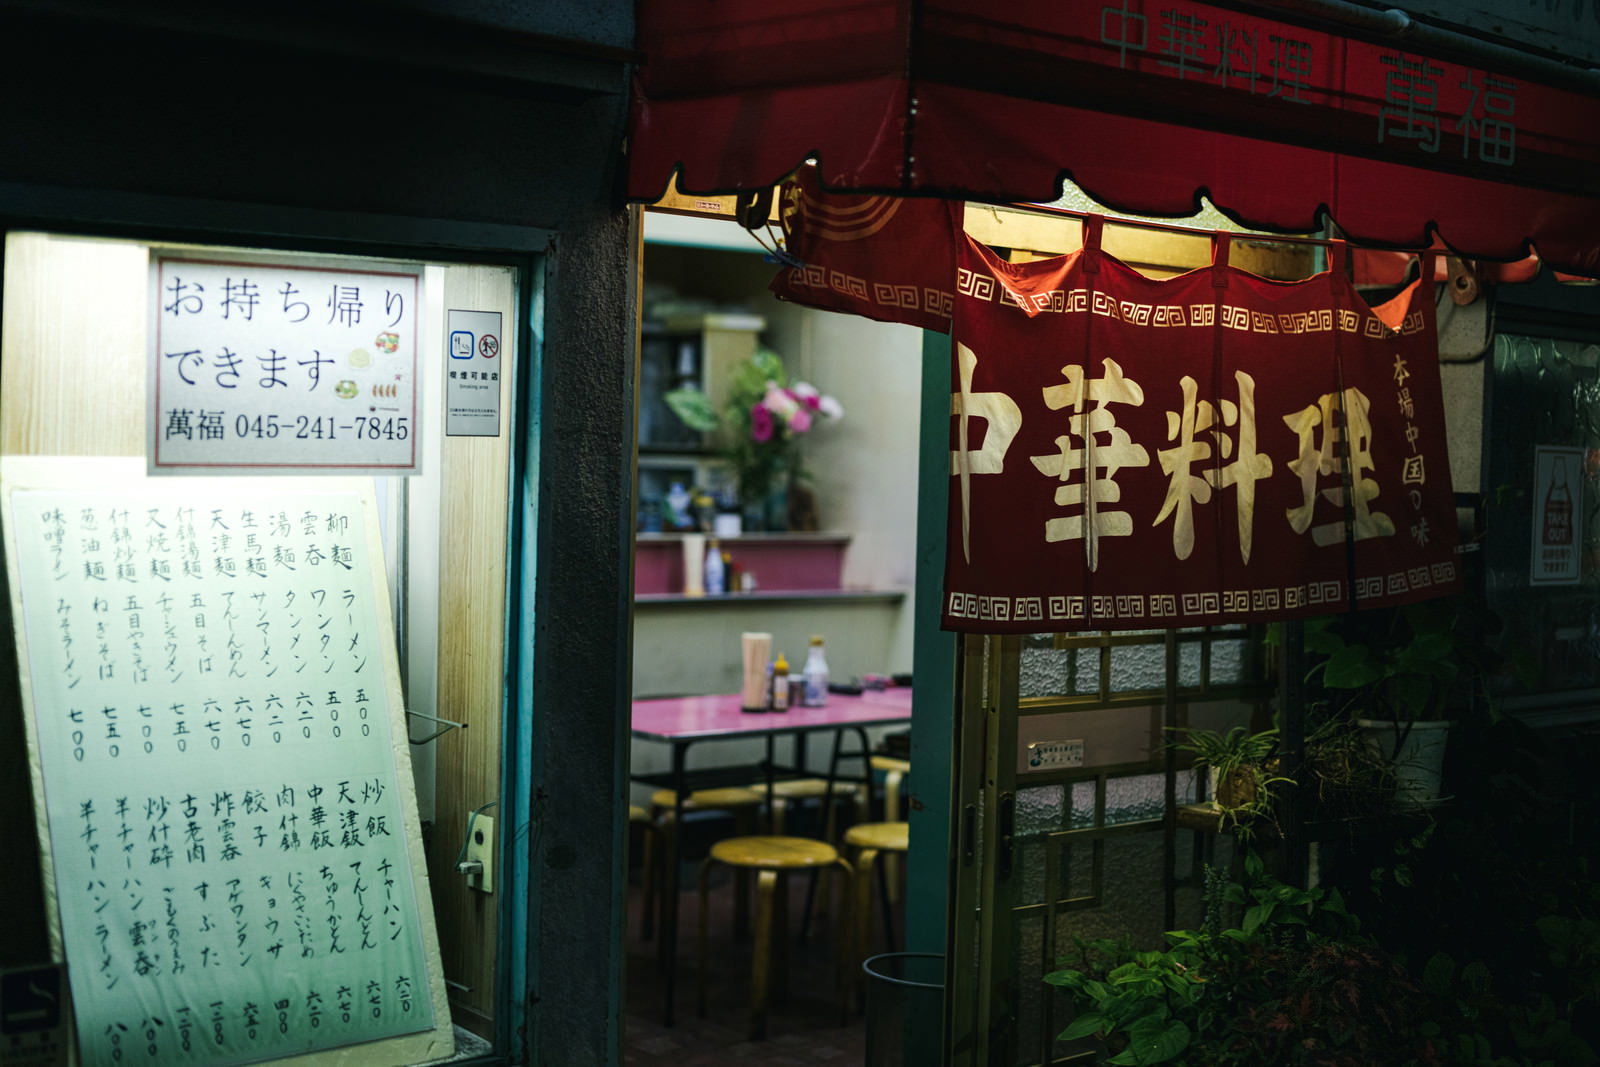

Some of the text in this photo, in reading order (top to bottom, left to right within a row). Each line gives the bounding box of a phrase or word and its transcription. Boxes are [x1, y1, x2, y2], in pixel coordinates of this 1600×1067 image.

[1101, 0, 1518, 166] 中華料理 萬福
[164, 275, 404, 328] お持ち帰り
[164, 346, 335, 392] できます
[164, 408, 409, 441] 萬福 045-241-7845
[951, 341, 1396, 573] 中華料理
[1393, 354, 1430, 548] 本場中国の味
[284, 590, 307, 673] タンメン
[311, 590, 335, 673] ワンタン
[342, 590, 366, 673] ラーメン
[242, 789, 268, 847] 餃子
[361, 778, 391, 838] 炒飯
[377, 858, 402, 940] チャーハン
